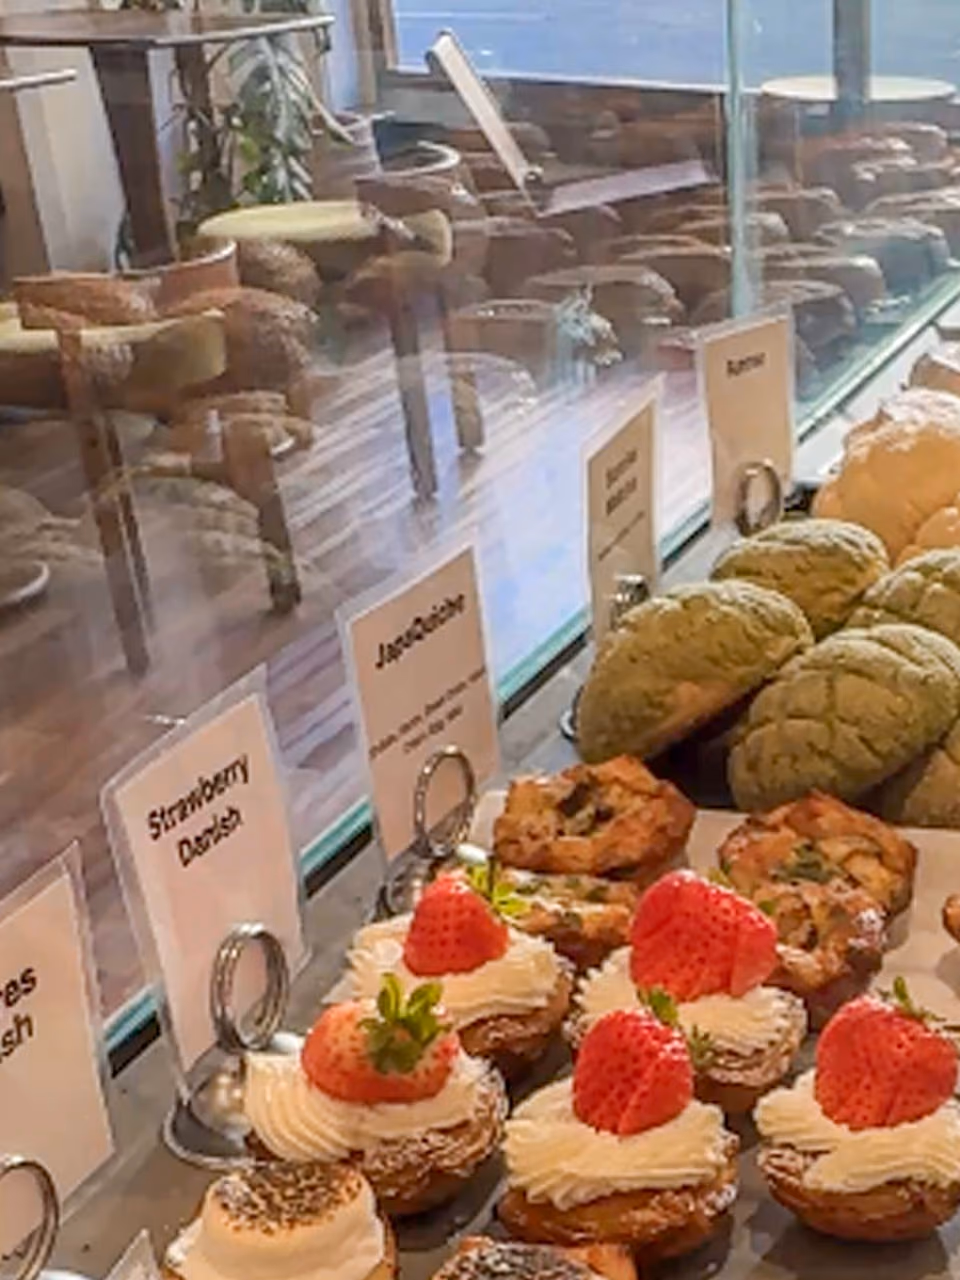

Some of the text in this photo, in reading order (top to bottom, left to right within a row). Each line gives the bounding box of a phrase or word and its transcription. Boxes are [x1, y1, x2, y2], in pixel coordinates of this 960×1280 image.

[148, 754, 249, 839] Strawberry
[178, 806, 243, 867] Danish
[0, 967, 37, 1007] es
